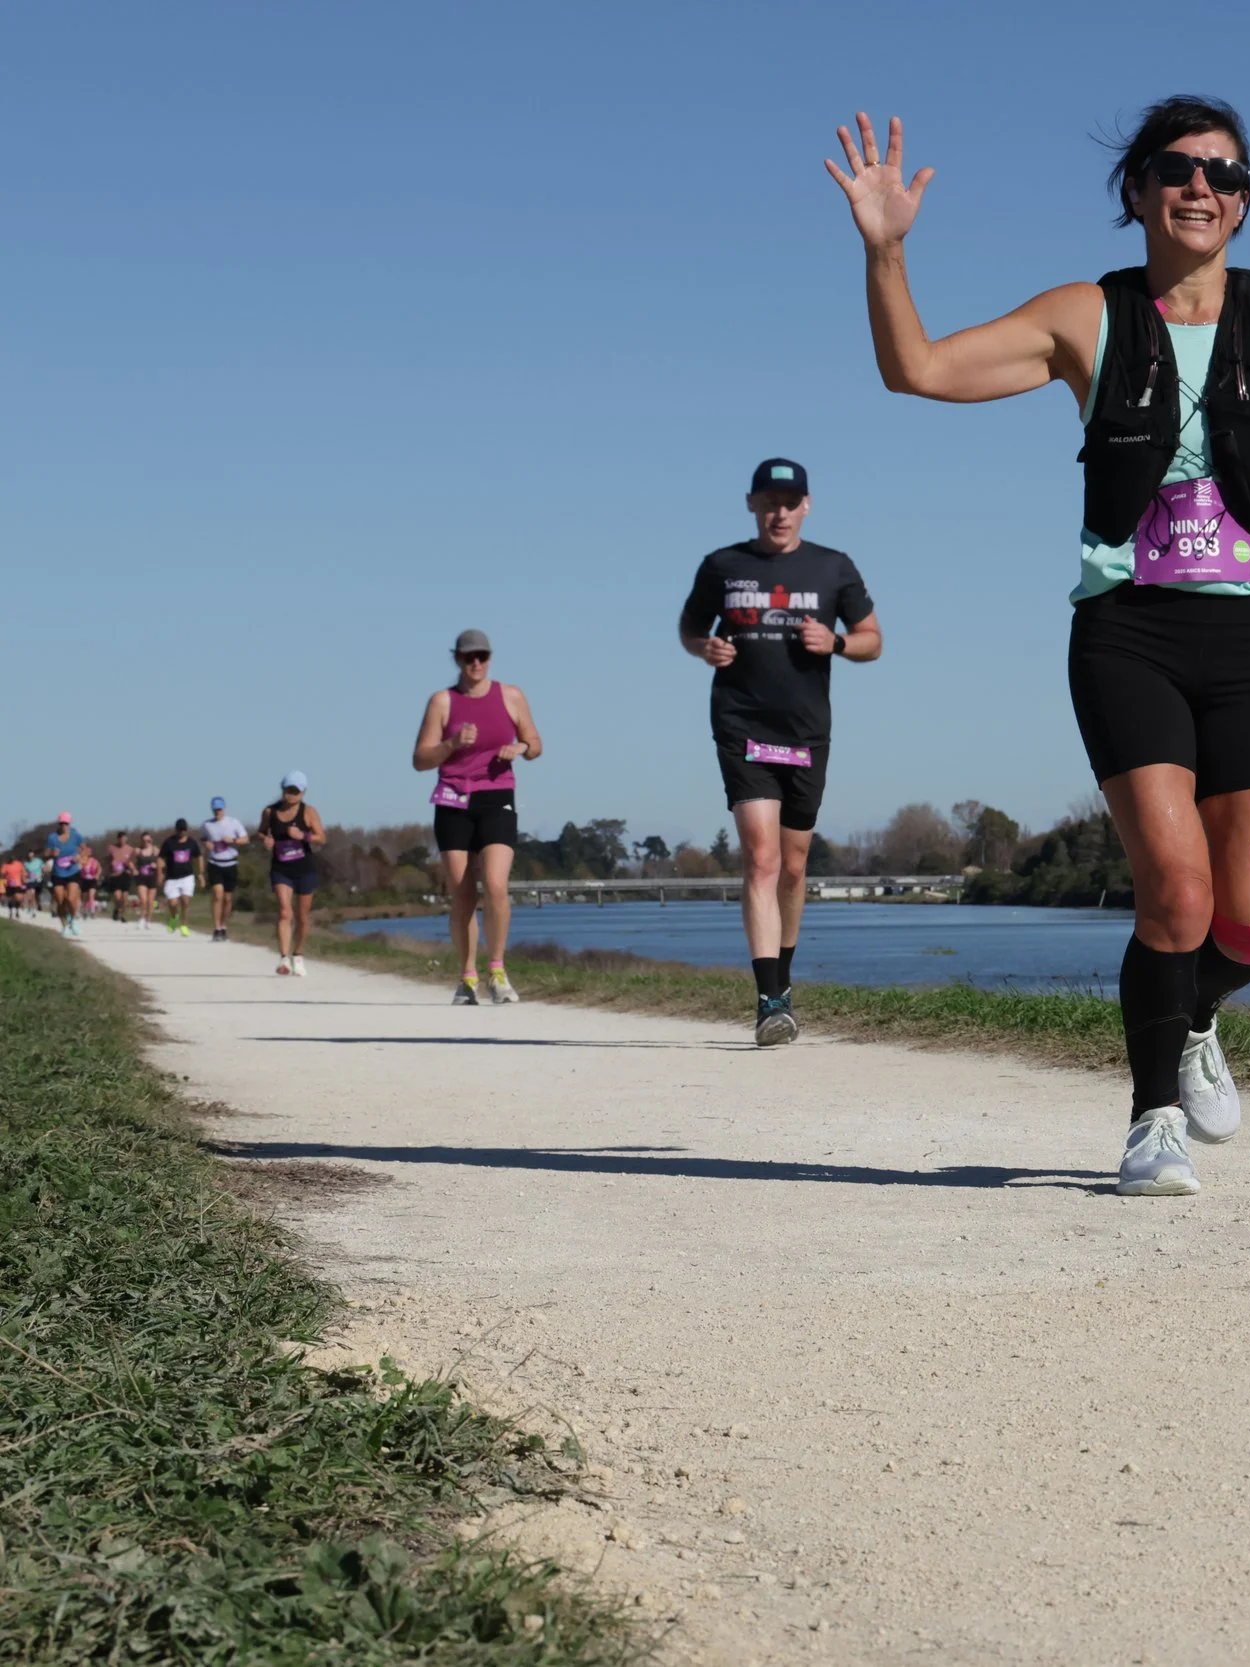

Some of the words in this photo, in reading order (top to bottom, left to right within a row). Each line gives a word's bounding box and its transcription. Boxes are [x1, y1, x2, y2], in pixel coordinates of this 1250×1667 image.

[1170, 519, 1220, 534] NINJA
[1178, 537, 1220, 557] 993
[724, 588, 819, 609] IRONMAN
